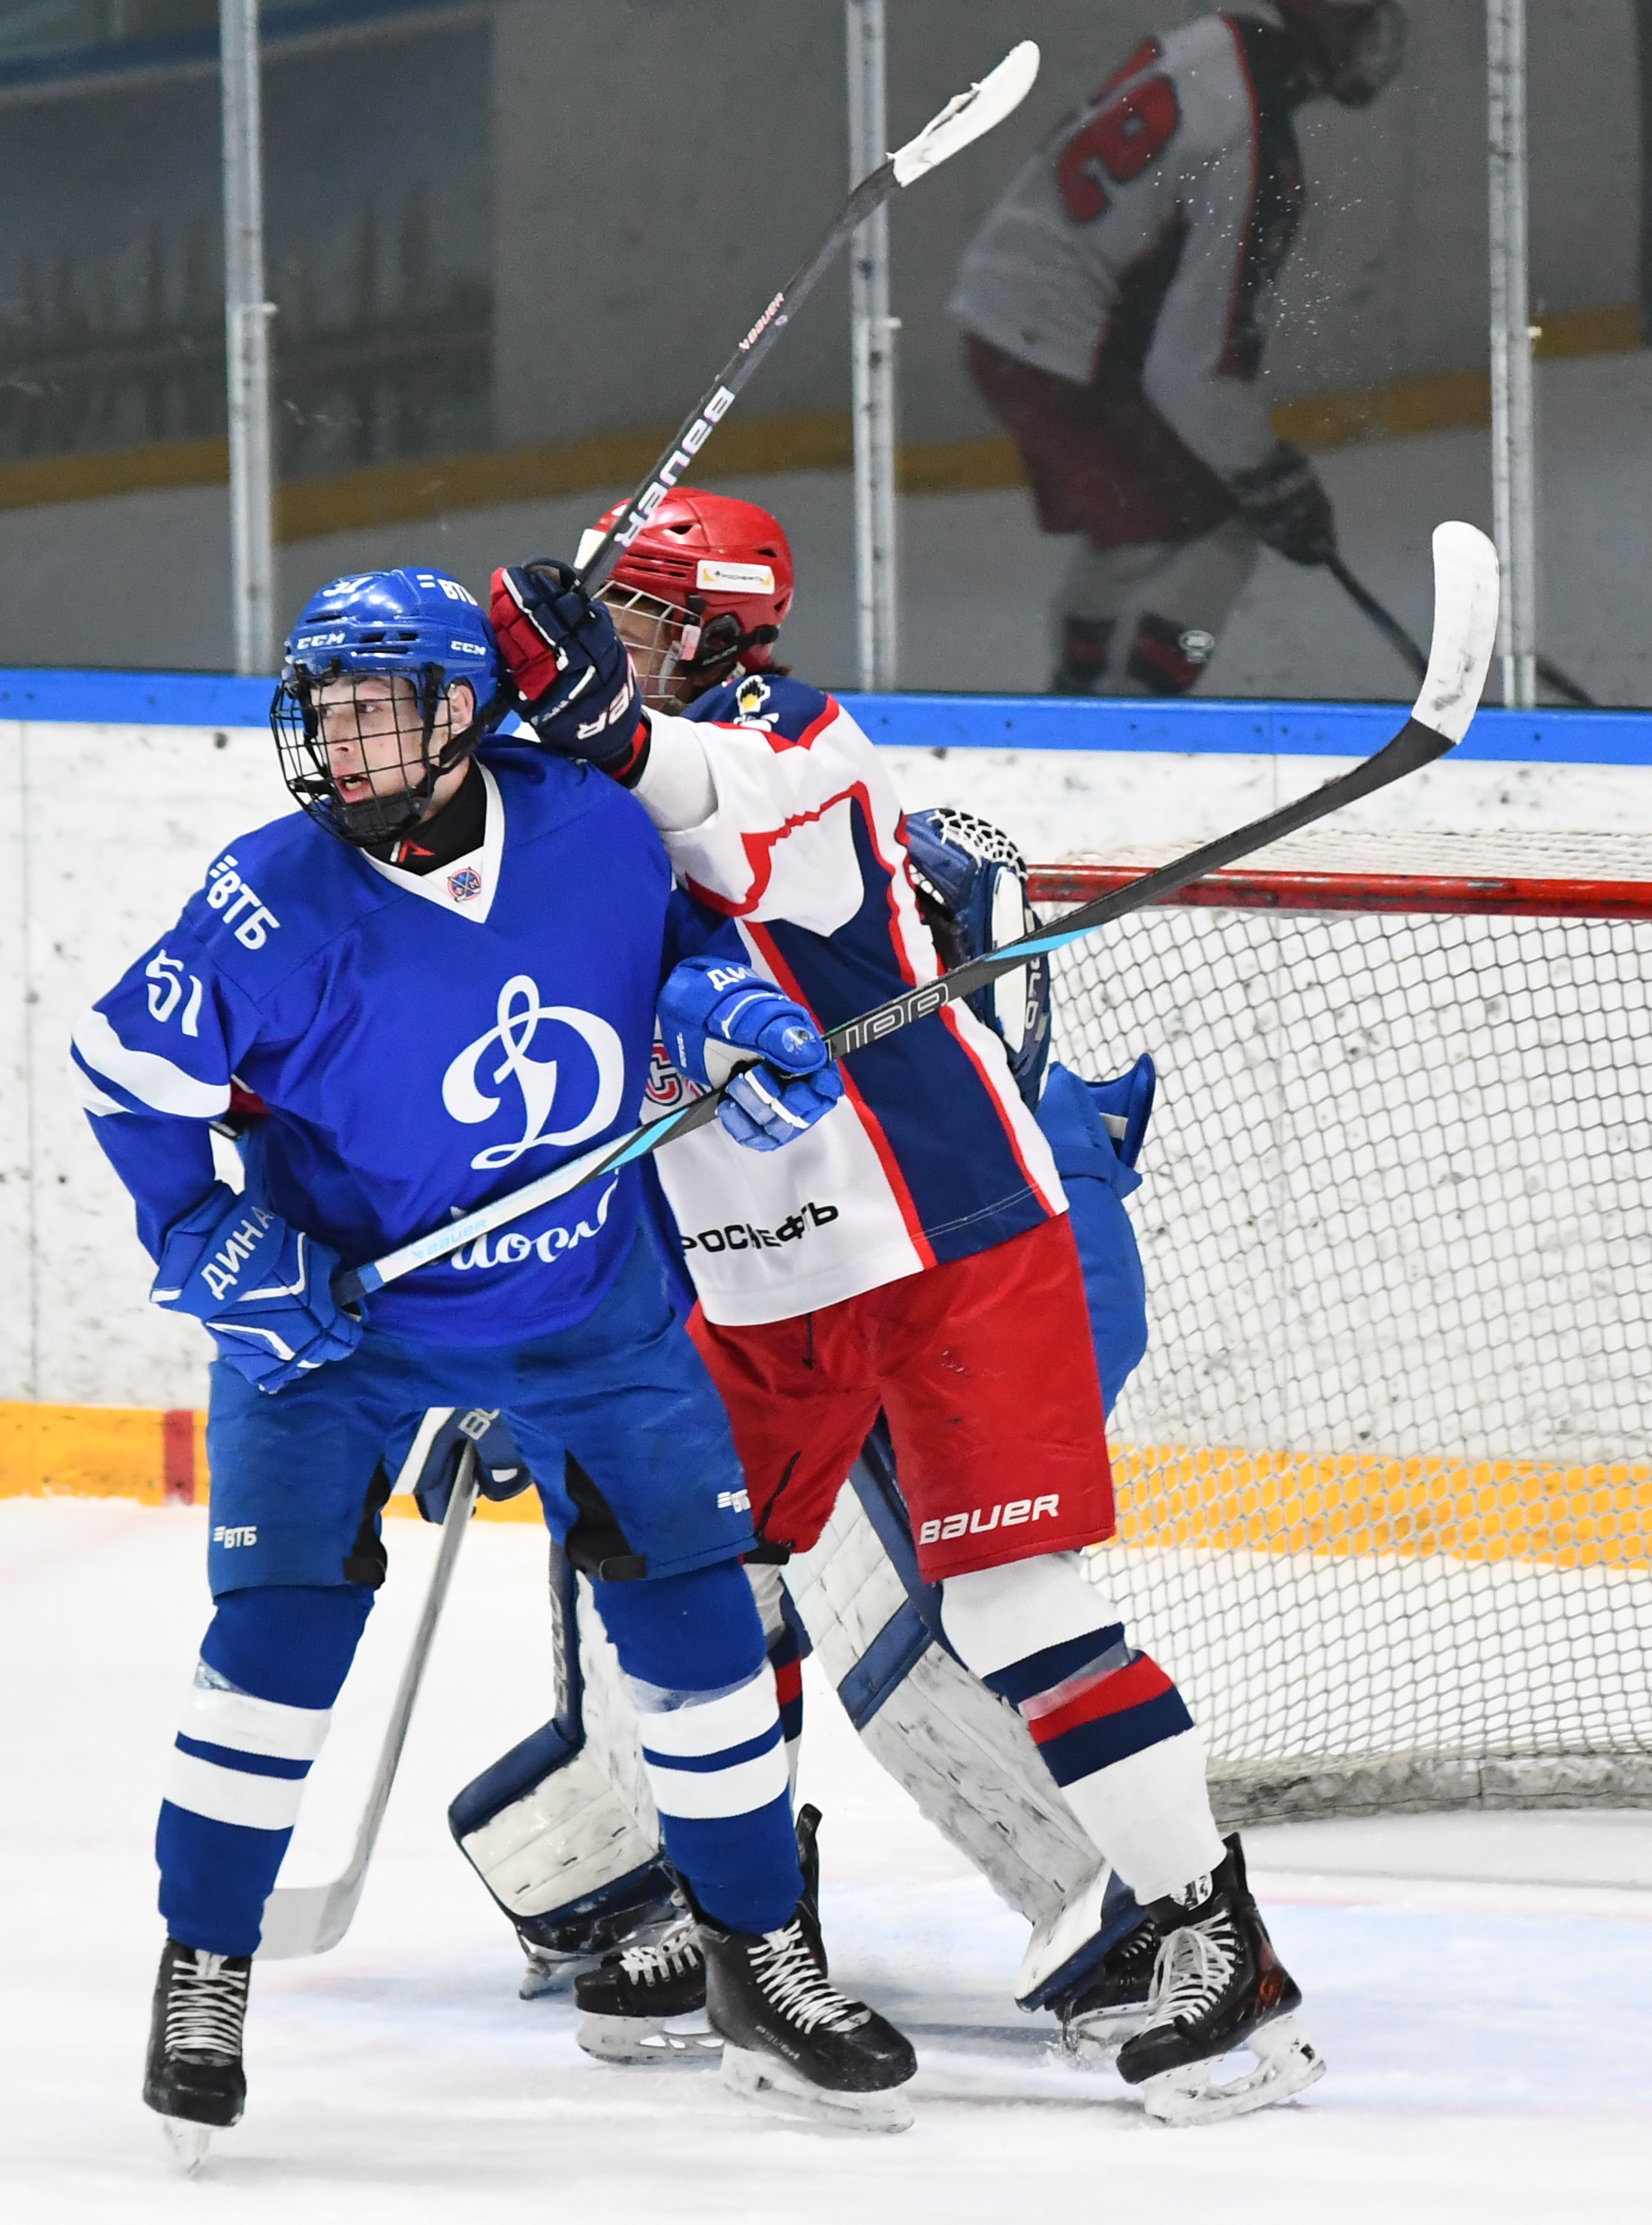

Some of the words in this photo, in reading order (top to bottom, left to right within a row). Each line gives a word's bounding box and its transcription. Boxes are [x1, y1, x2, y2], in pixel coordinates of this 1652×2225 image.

[614, 385, 735, 547] BAUER
[297, 633, 346, 650] CCM
[451, 640, 487, 655] CCM
[207, 869, 281, 950] ВТБ
[145, 949, 203, 1038] 51
[224, 1526, 258, 1549] ВТБ
[919, 1493, 1060, 1546] BAUER
